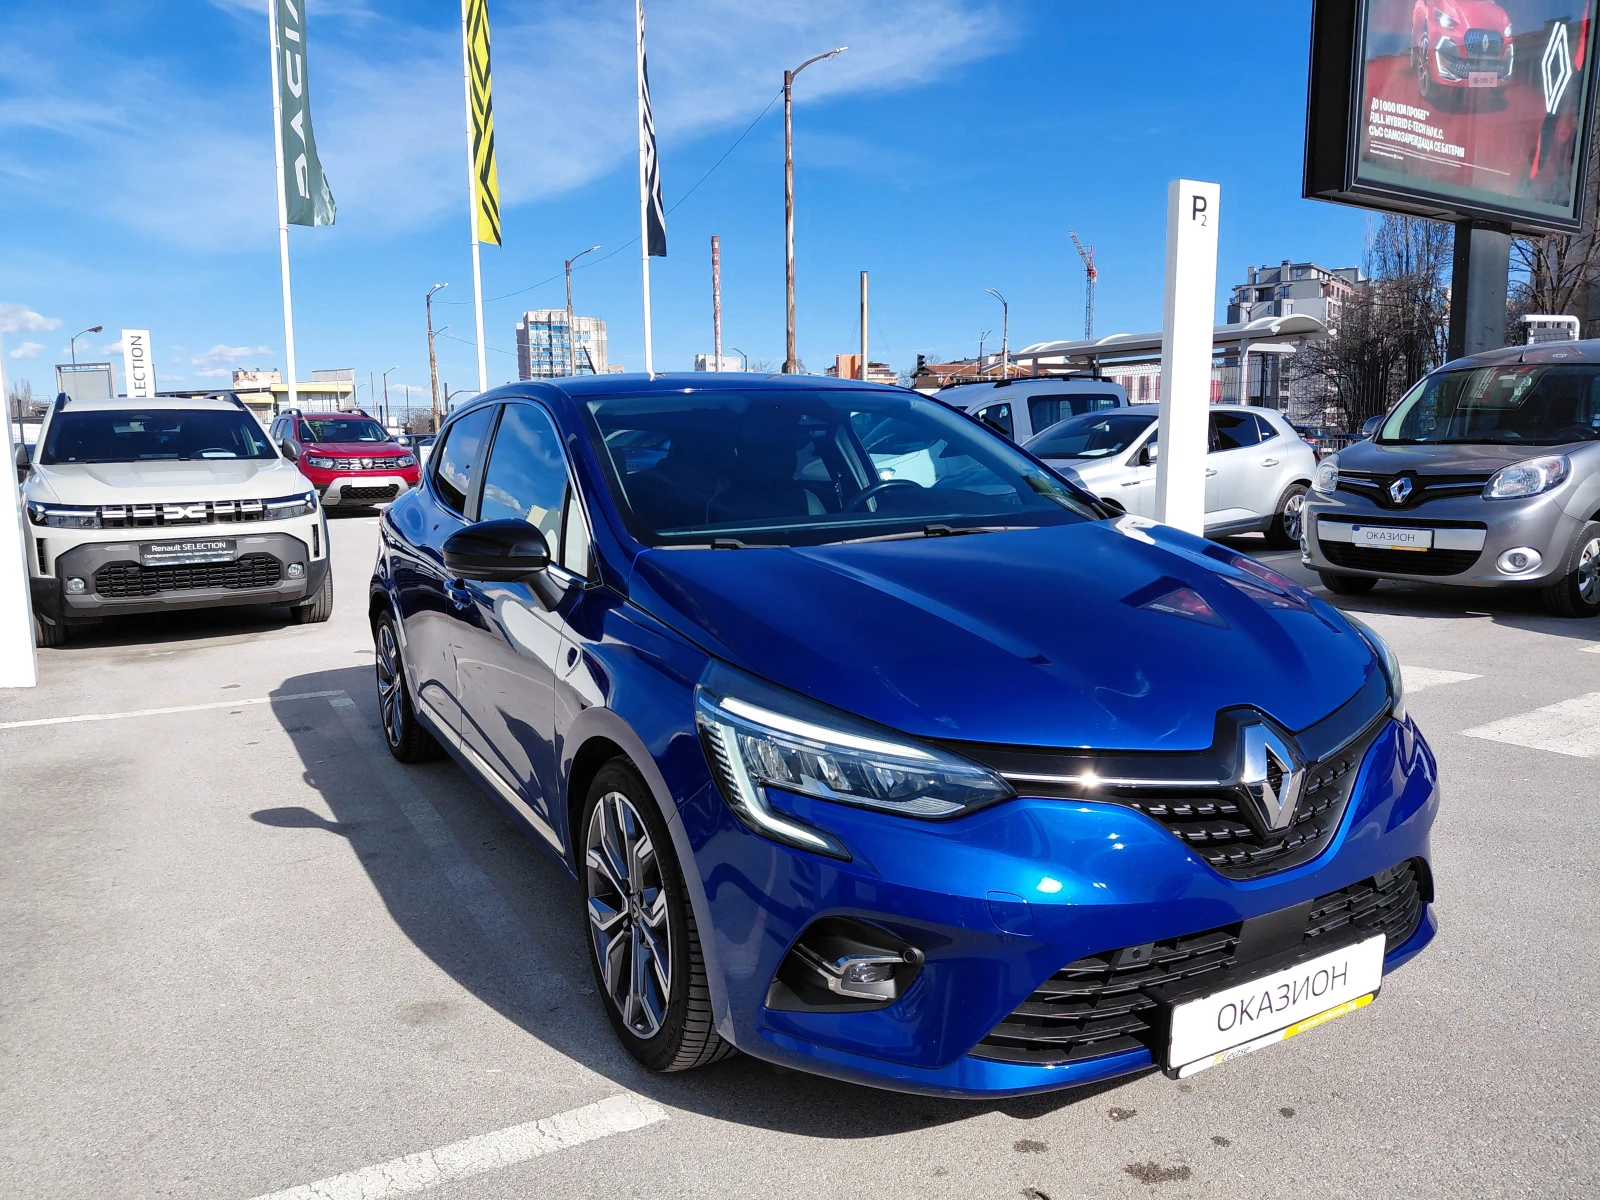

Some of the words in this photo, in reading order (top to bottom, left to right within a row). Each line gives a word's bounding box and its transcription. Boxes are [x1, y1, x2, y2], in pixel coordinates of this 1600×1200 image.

[1396, 103, 1407, 115] КМ
[1369, 111, 1386, 124] FULL
[1385, 114, 1408, 129] HYBRID
[1407, 120, 1426, 135] E-TECH
[1368, 125, 1384, 138] СЪС
[1441, 142, 1466, 158] БАТЕРИЯ
[130, 335, 147, 398] LECTION
[151, 544, 181, 553] Renault
[182, 541, 226, 551] SELECTION
[1366, 531, 1415, 542] ОКАЗИОН
[1217, 961, 1348, 1032] ОКАЗИОН
